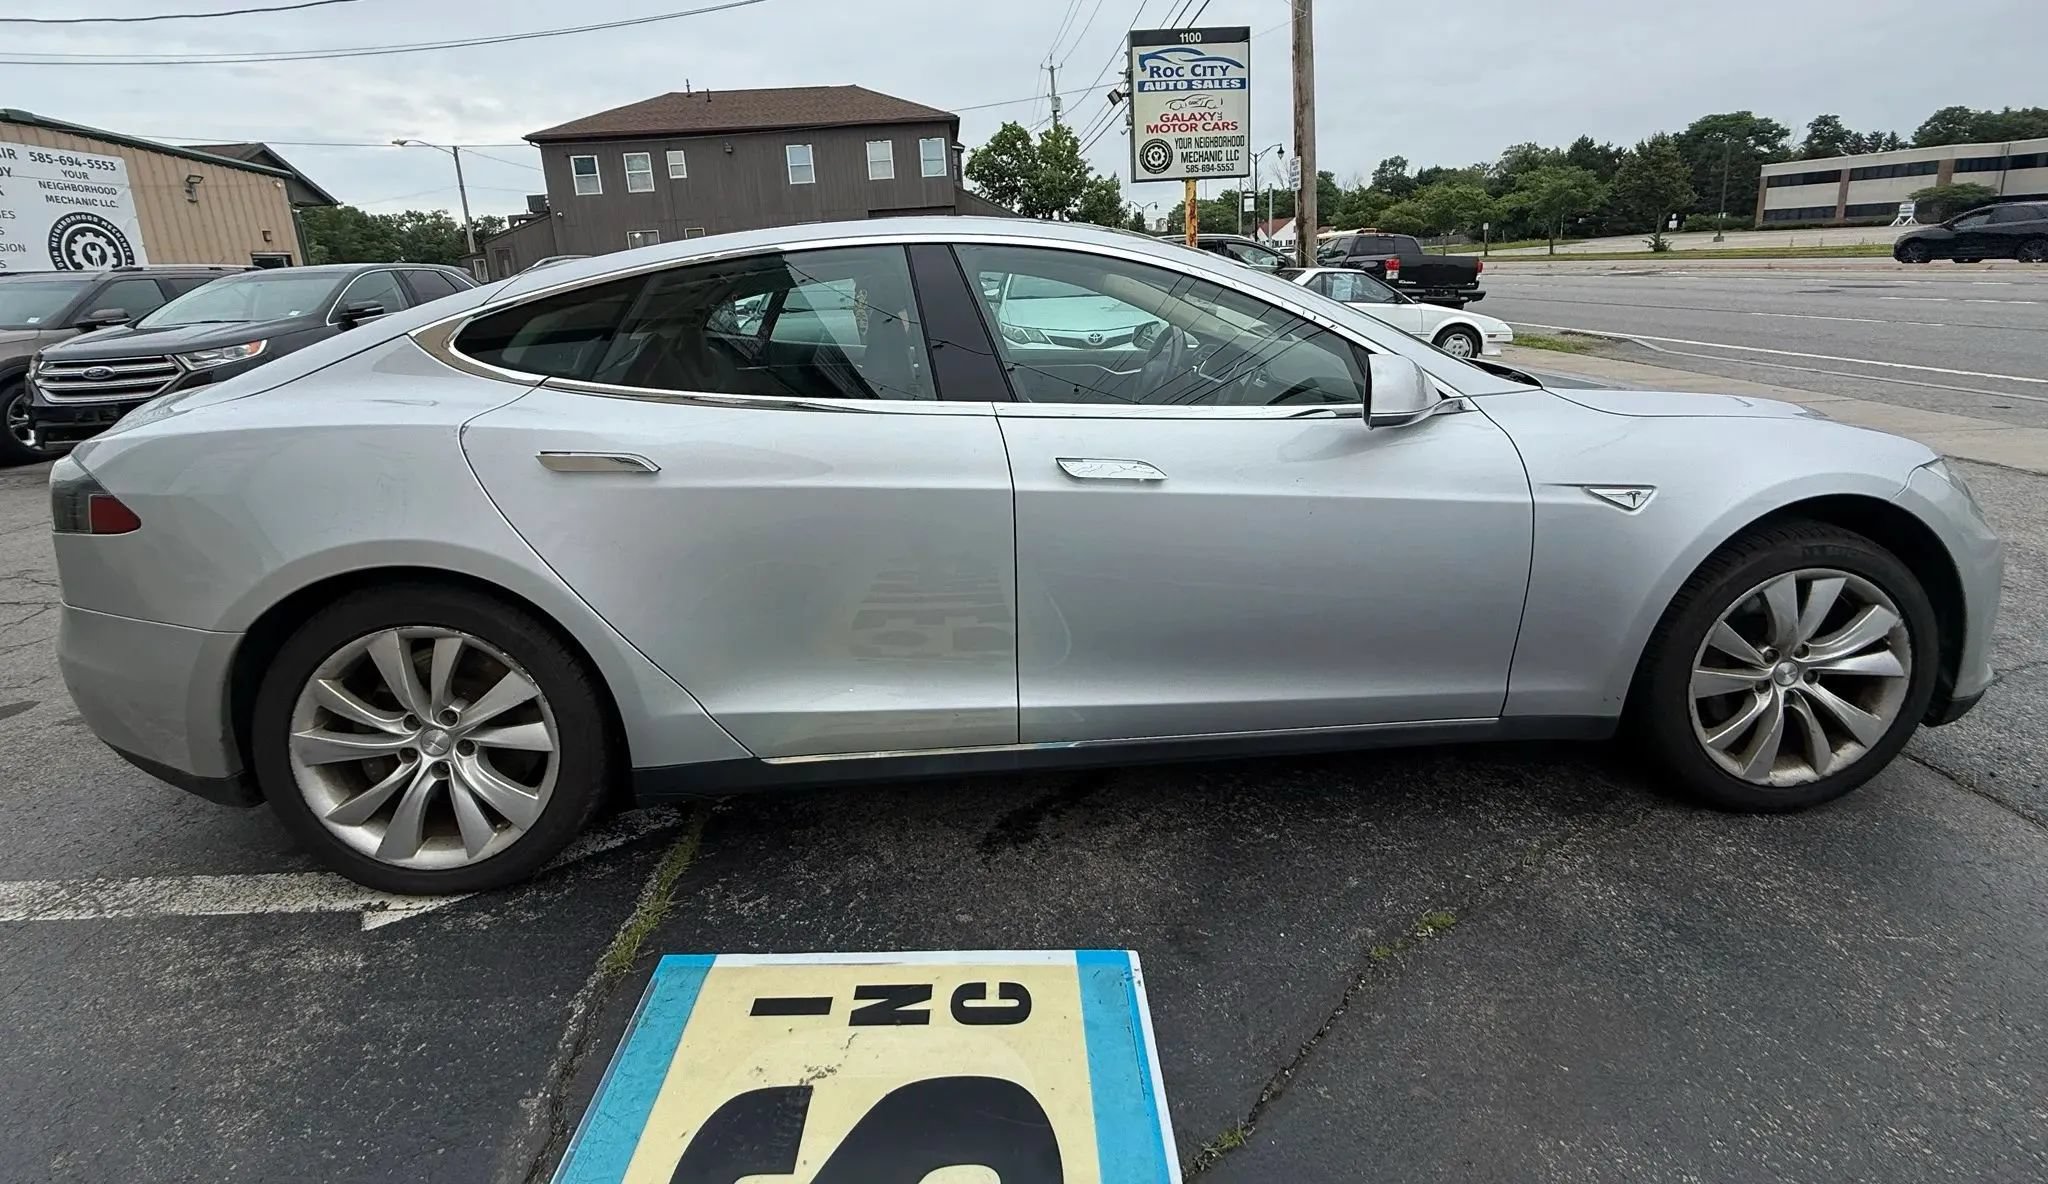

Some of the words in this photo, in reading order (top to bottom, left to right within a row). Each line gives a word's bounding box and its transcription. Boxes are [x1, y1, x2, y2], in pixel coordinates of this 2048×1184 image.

[1179, 32, 1202, 43] 1100
[1149, 65, 1185, 78] ROC
[1190, 64, 1230, 77] CITY
[1143, 80, 1188, 91] AUTO
[1191, 79, 1241, 89] SALES
[1160, 112, 1216, 122] GALAXY
[1146, 123, 1198, 134] MOTOR
[1202, 121, 1238, 131] CARS
[1174, 137, 1192, 149] YOUR
[1194, 135, 1245, 148] NEIGHBORHOOD
[29, 151, 116, 171] 585-694-5553
[1180, 150, 1223, 163] MECHANIC
[1225, 149, 1240, 161] LLC
[61, 169, 90, 180] YOUR
[1185, 163, 1235, 173] 585-694-5553
[38, 180, 117, 196] NEIGHBORHOOD
[45, 194, 98, 206] MECHANIC
[101, 220, 132, 256] MECHANIC
